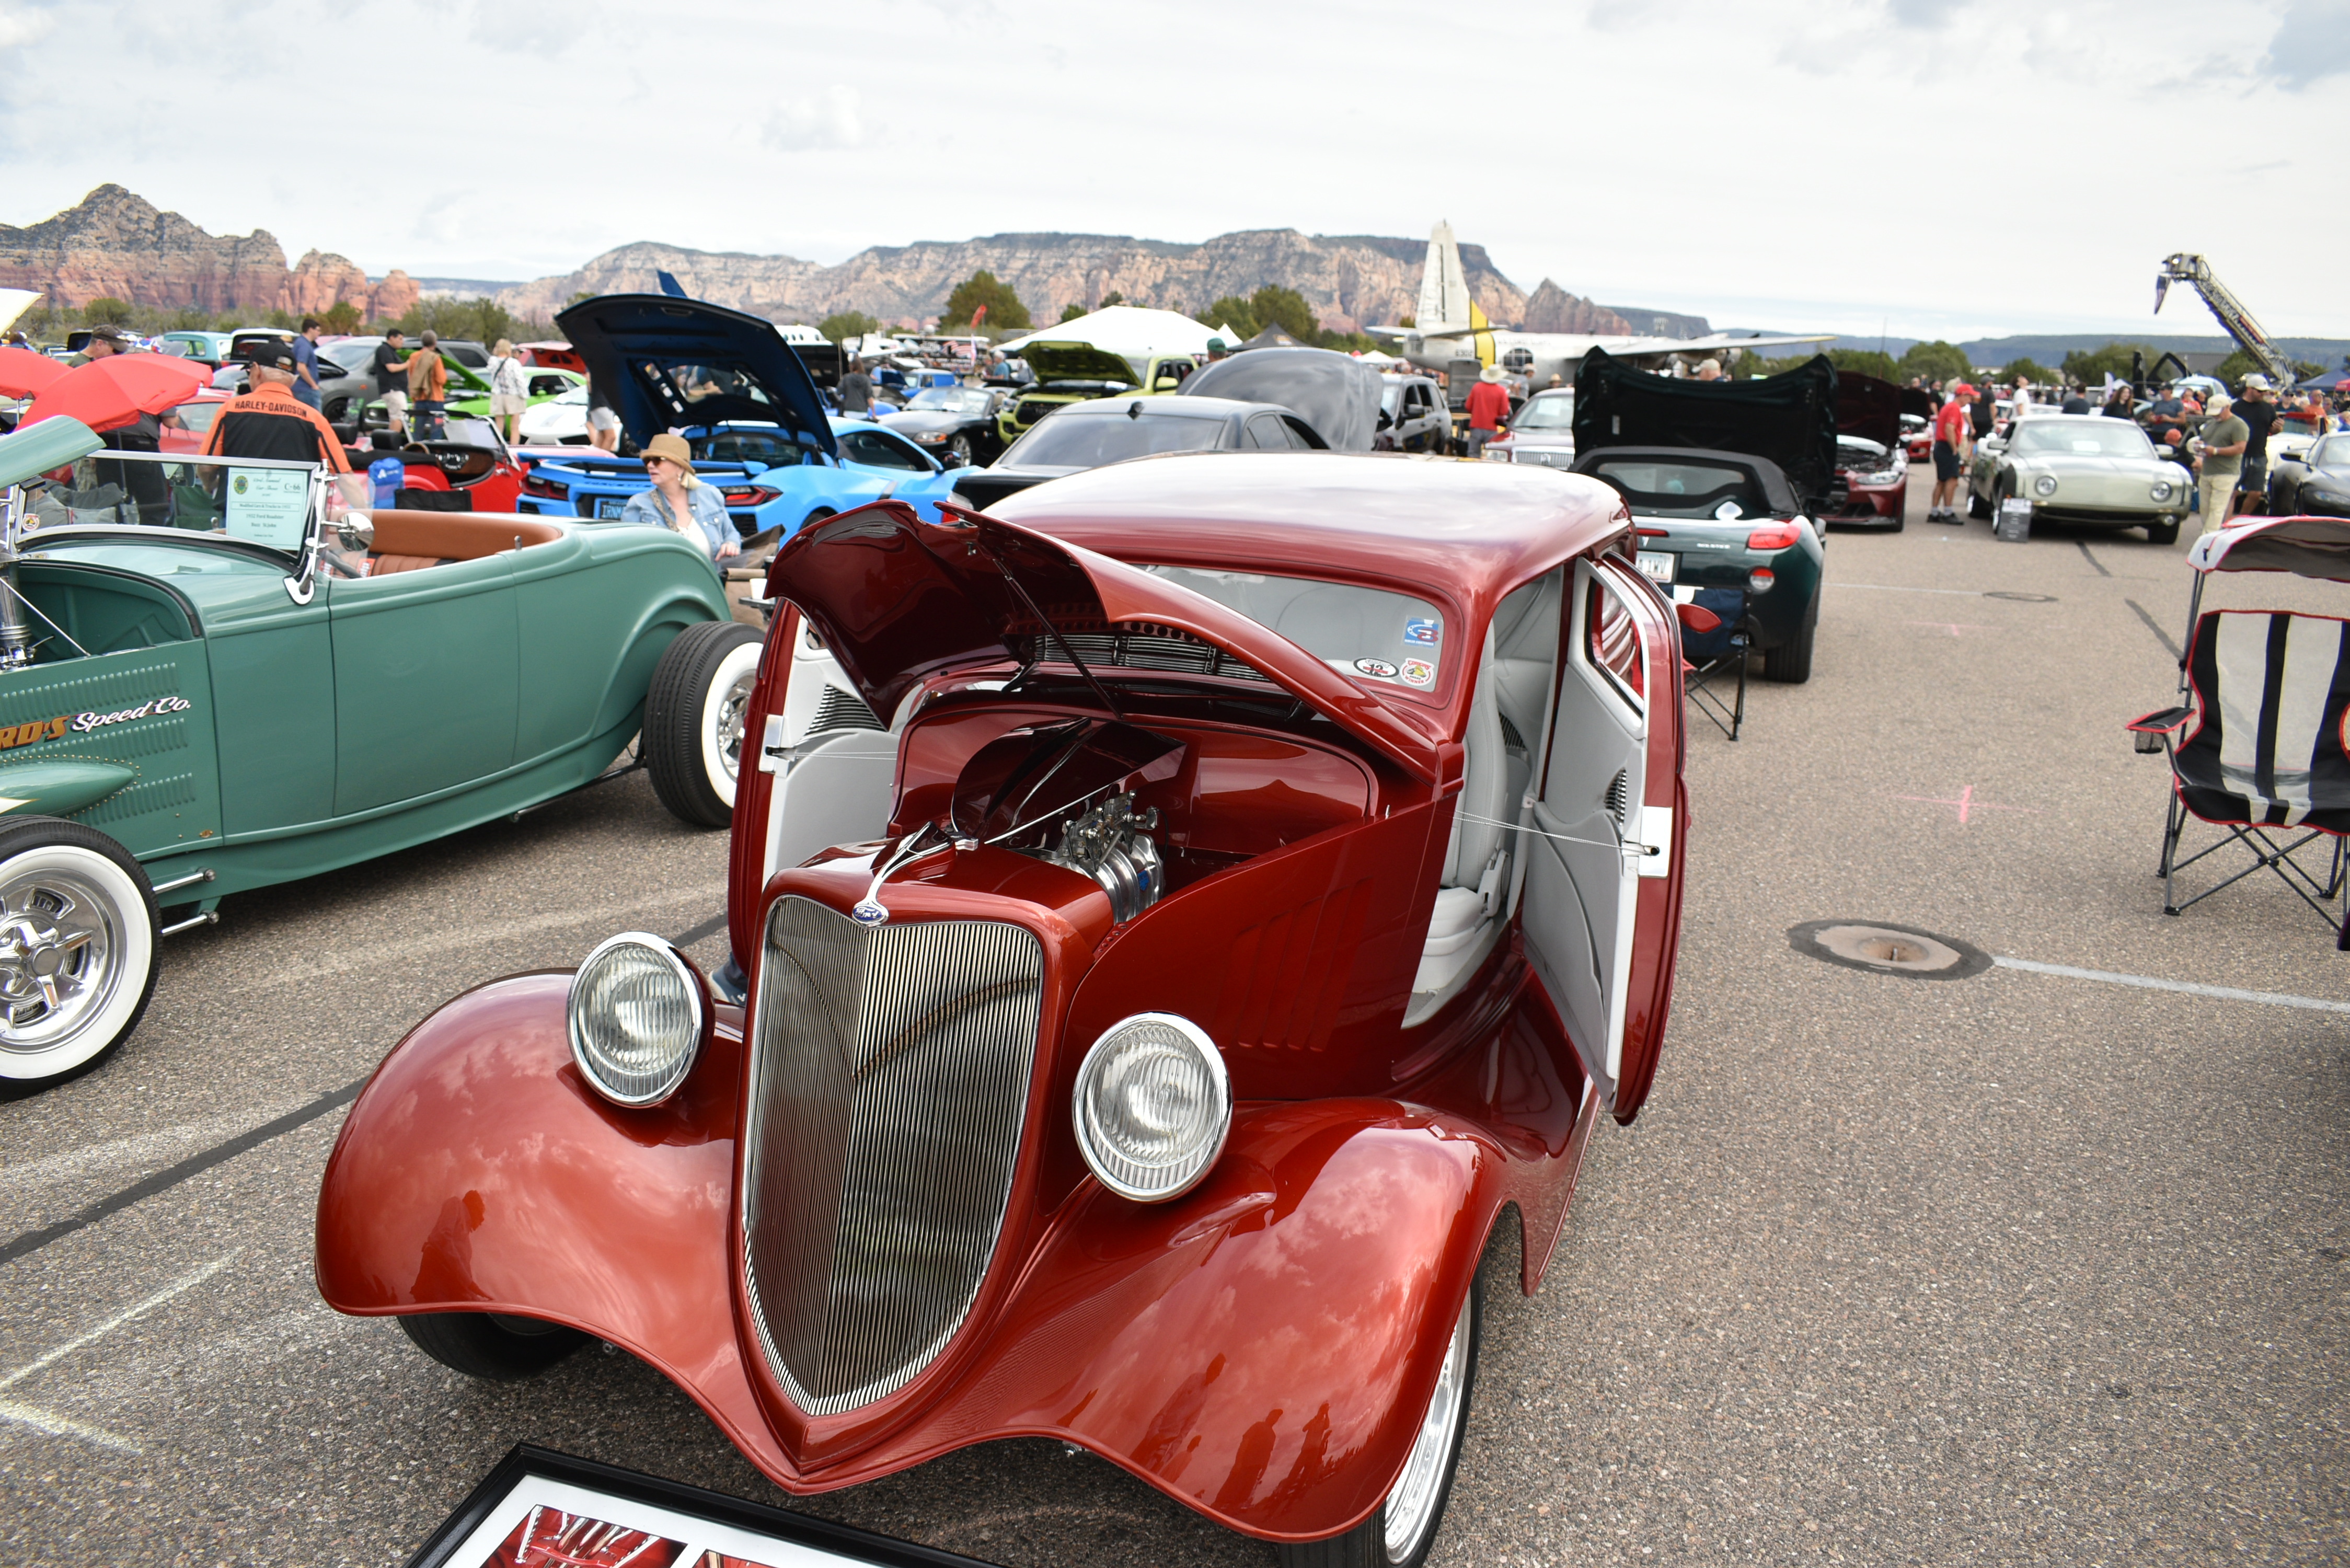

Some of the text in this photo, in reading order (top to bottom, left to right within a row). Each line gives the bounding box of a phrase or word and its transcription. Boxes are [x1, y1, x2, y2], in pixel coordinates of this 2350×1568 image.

[235, 400, 307, 418] HARLEY-DAVIDSON
[1405, 675, 1424, 684] WINNER
[71, 700, 154, 733] Speed
[154, 696, 191, 714] Co.
[855, 906, 879, 918] Ford
